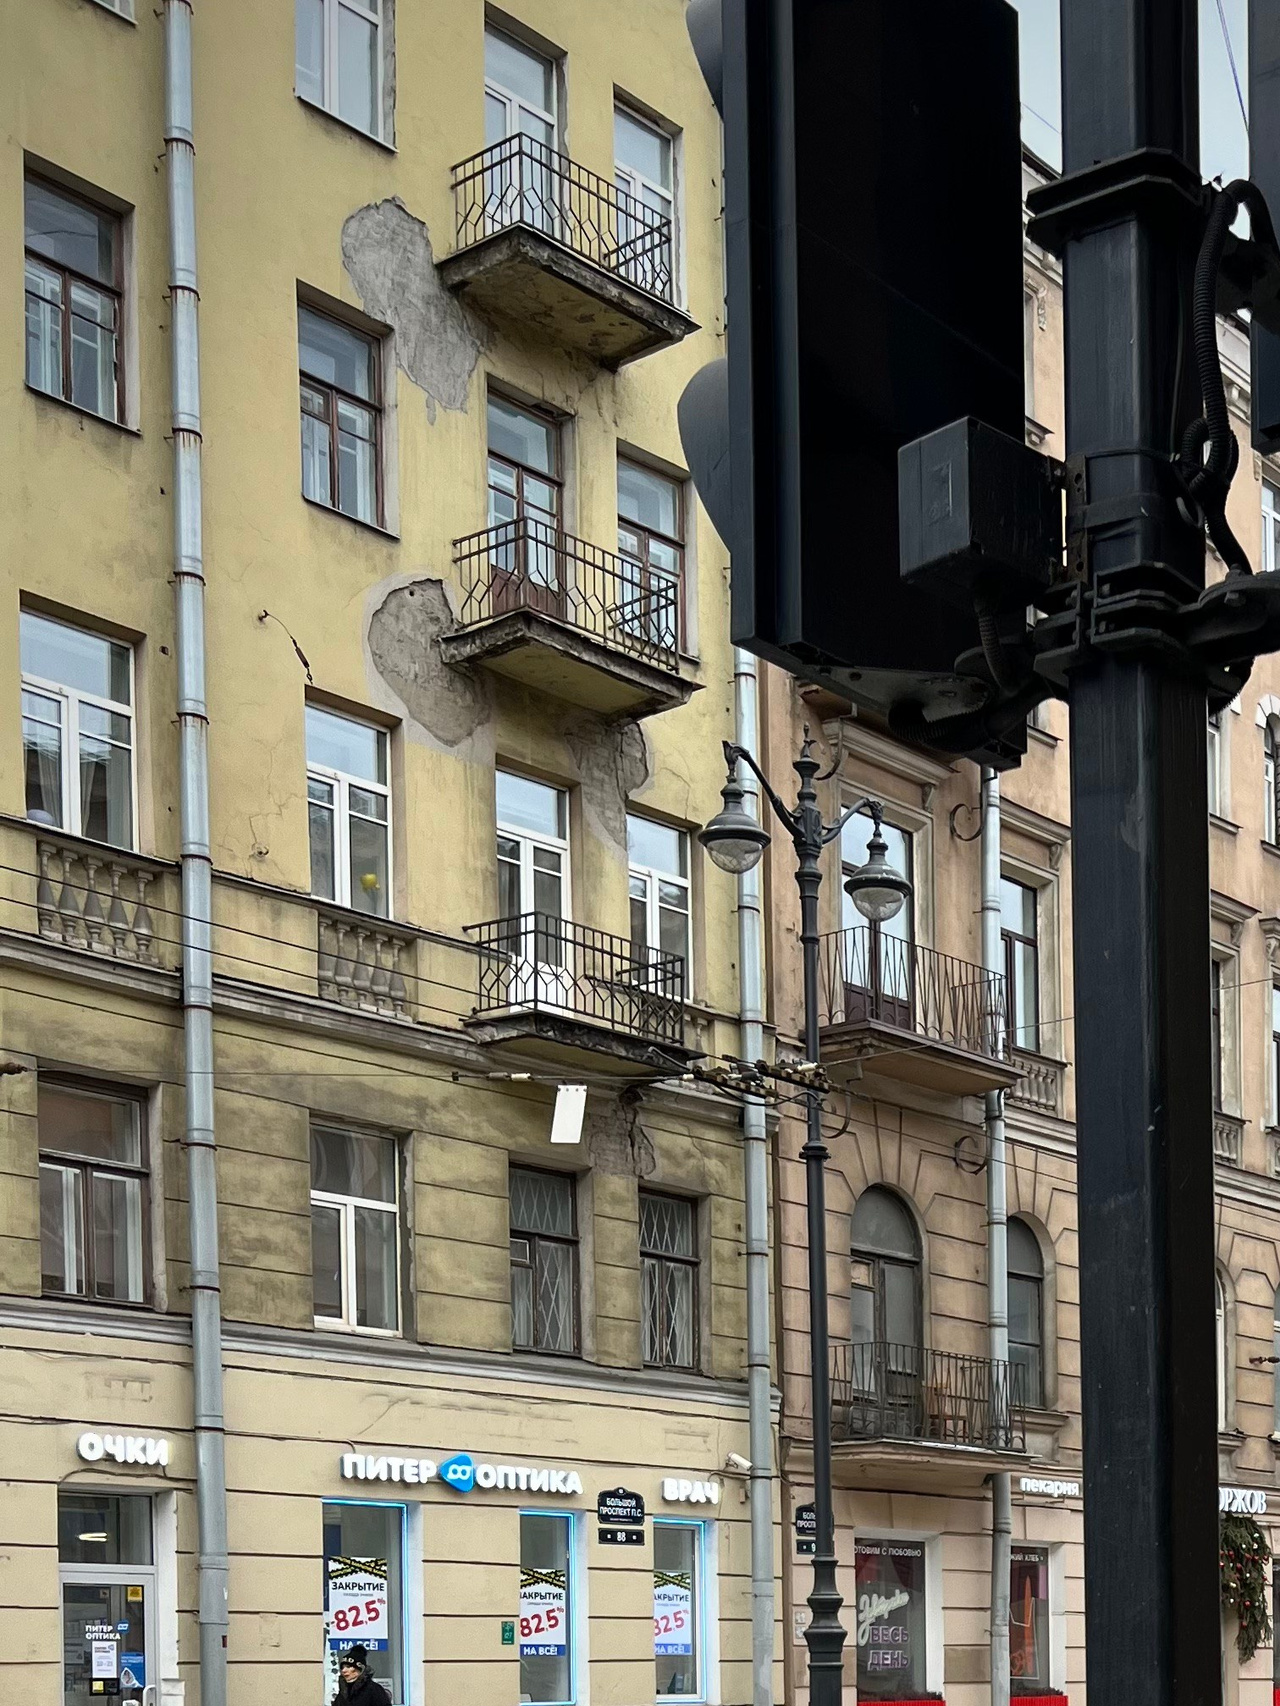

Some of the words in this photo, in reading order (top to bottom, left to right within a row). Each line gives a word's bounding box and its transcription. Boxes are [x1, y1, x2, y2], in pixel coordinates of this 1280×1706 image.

[77, 1432, 168, 1466] ОЧКИ
[340, 1453, 437, 1484] ПИТЕР
[476, 1464, 583, 1495] ОПТИКА
[662, 1477, 719, 1504] ВРАЧ
[1020, 1478, 1079, 1497] пекарня
[606, 1497, 636, 1507] БОЛЬШОЙ
[599, 1506, 631, 1517] ПРОСПЕКТ
[888, 1547, 922, 1557] ЛЮБОВЬЮ
[331, 1582, 385, 1591] ЗАКРЫТИЕ
[330, 1598, 386, 1632] -82,5%
[85, 1625, 113, 1633] ПИТЕР
[85, 1632, 121, 1640] ОПТИКА
[869, 1626, 910, 1644] ВЕСЬ
[523, 1646, 537, 1655] НА
[538, 1644, 557, 1655] ВСЁ!
[654, 1645, 666, 1653] НА
[867, 1650, 909, 1671] ДЕНЬ
